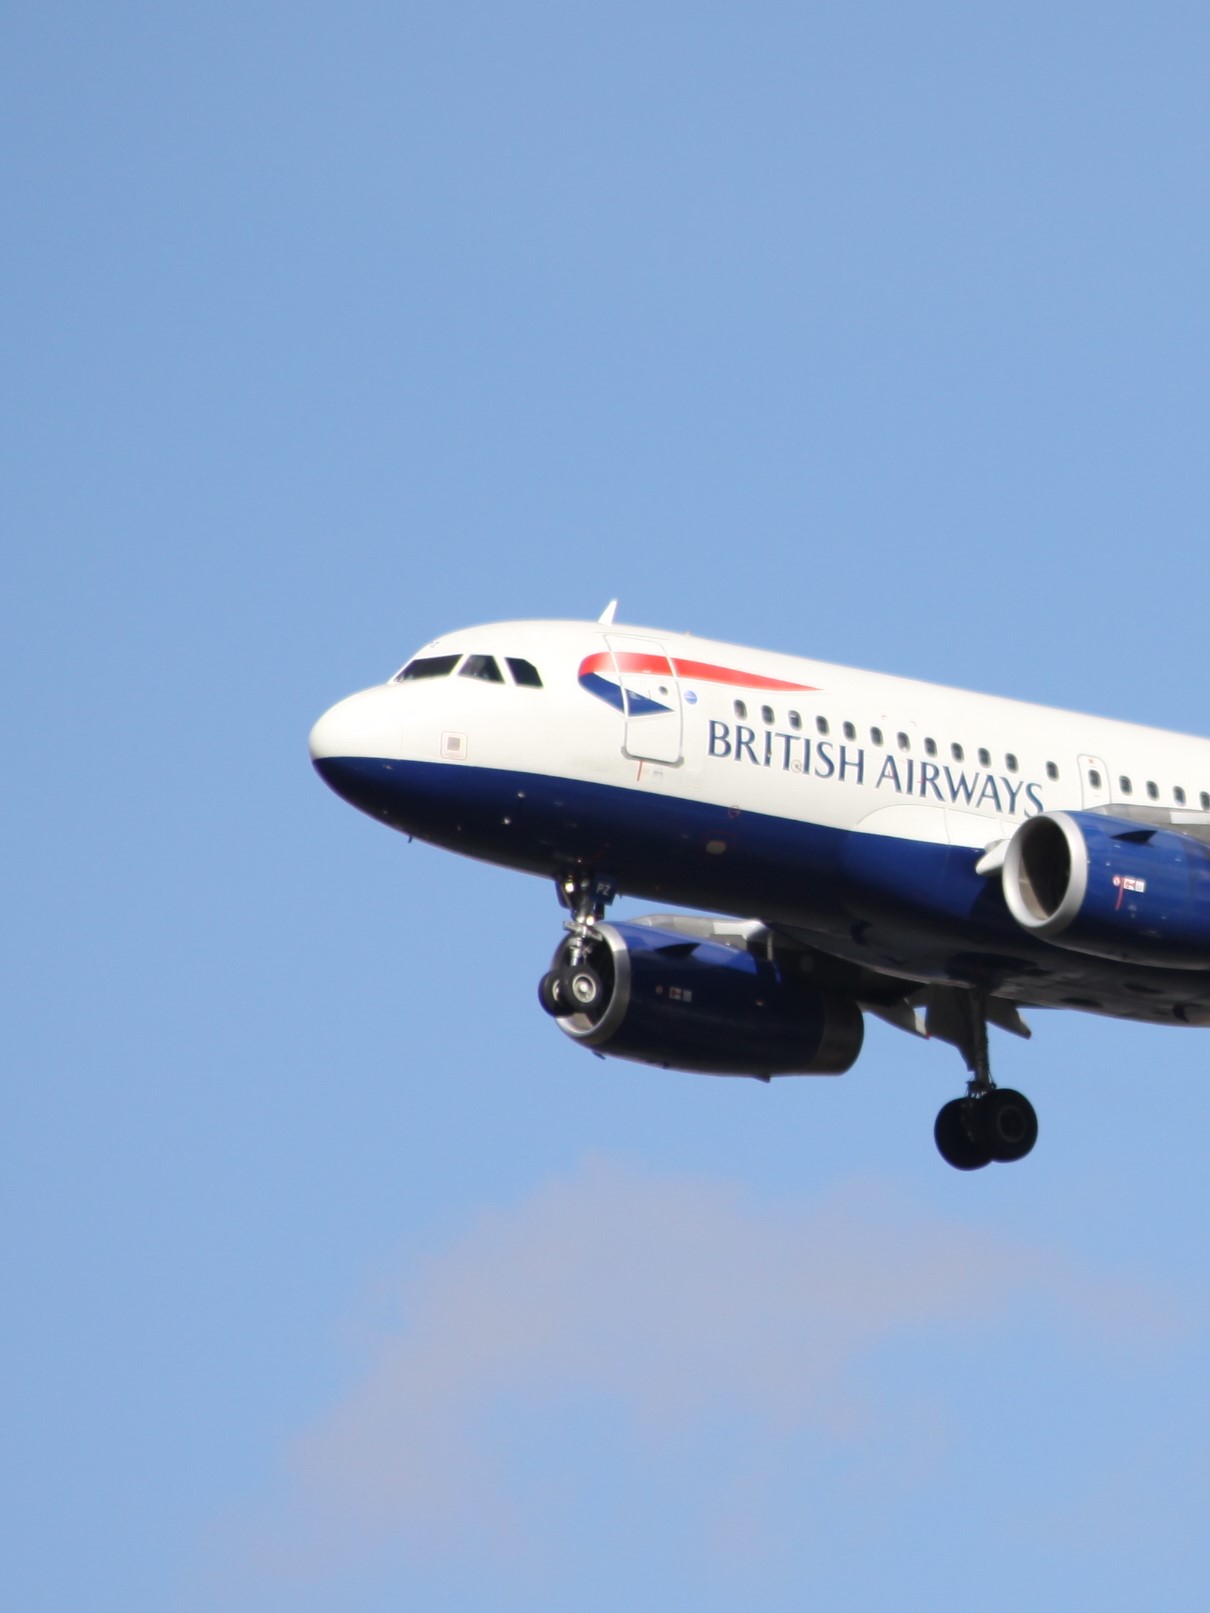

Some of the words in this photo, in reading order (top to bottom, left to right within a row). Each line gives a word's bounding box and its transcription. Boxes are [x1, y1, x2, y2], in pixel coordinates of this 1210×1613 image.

[707, 719, 865, 785] BRITISH
[875, 754, 1044, 818] AIRWAYS
[596, 882, 611, 896] PZ
